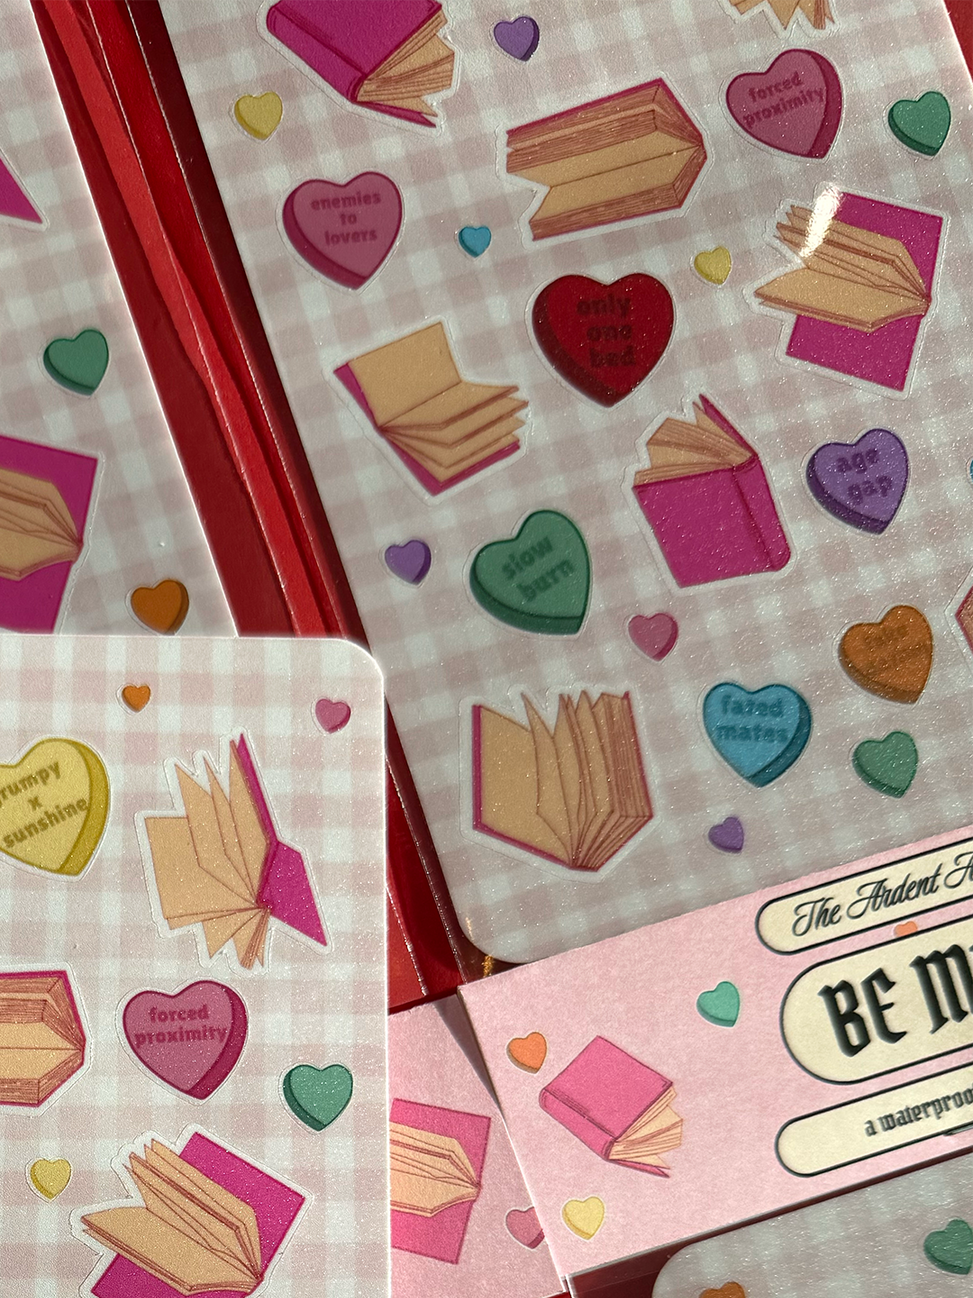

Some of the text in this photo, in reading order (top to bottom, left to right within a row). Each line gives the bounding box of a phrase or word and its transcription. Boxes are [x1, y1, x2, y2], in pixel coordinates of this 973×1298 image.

[747, 71, 803, 103] forced
[743, 88, 827, 127] proximity
[310, 190, 382, 211] enemies
[339, 213, 357, 226] to
[324, 229, 378, 246] lovers
[576, 293, 631, 319] only
[587, 325, 633, 343] one
[836, 448, 878, 475] age
[847, 476, 894, 507] gap
[500, 535, 554, 581] slow
[517, 558, 576, 602] burn
[719, 694, 785, 719] fated
[715, 724, 789, 744] mates
[27, 795, 44, 812] x
[3, 797, 89, 850] sunshine
[791, 897, 843, 938] The
[846, 862, 945, 921] Ardent
[147, 1002, 210, 1025] forced
[817, 966, 910, 1058] BE
[134, 1023, 230, 1050] proximity
[863, 1082, 973, 1138] a waterproo
